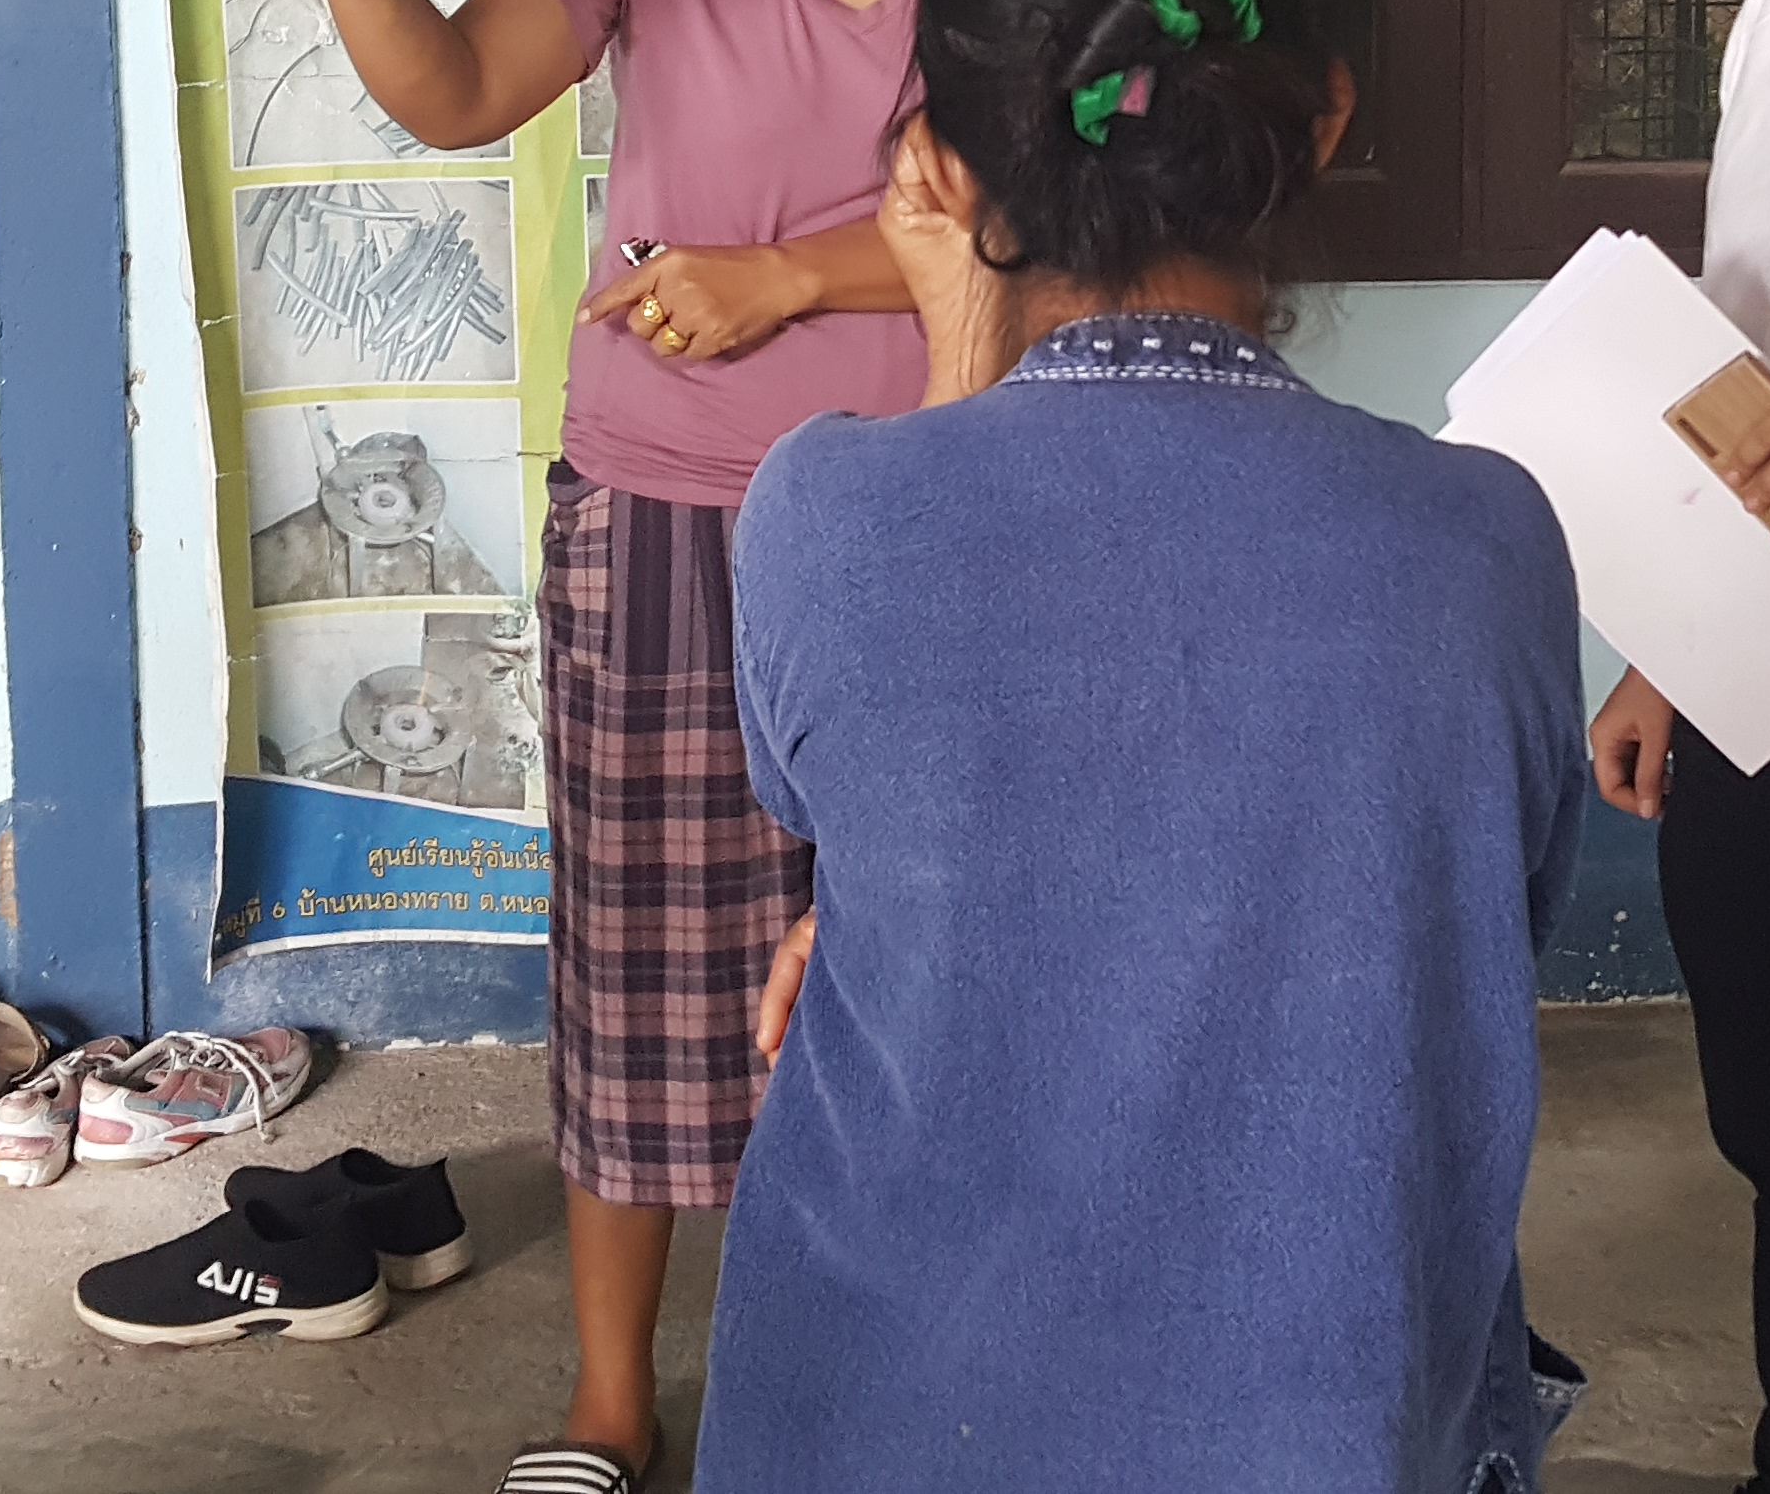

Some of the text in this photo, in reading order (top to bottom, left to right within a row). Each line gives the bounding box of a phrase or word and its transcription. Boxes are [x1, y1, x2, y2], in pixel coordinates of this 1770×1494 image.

[271, 900, 287, 920] 6
[297, 887, 468, 918] บ้านหนองทราย
